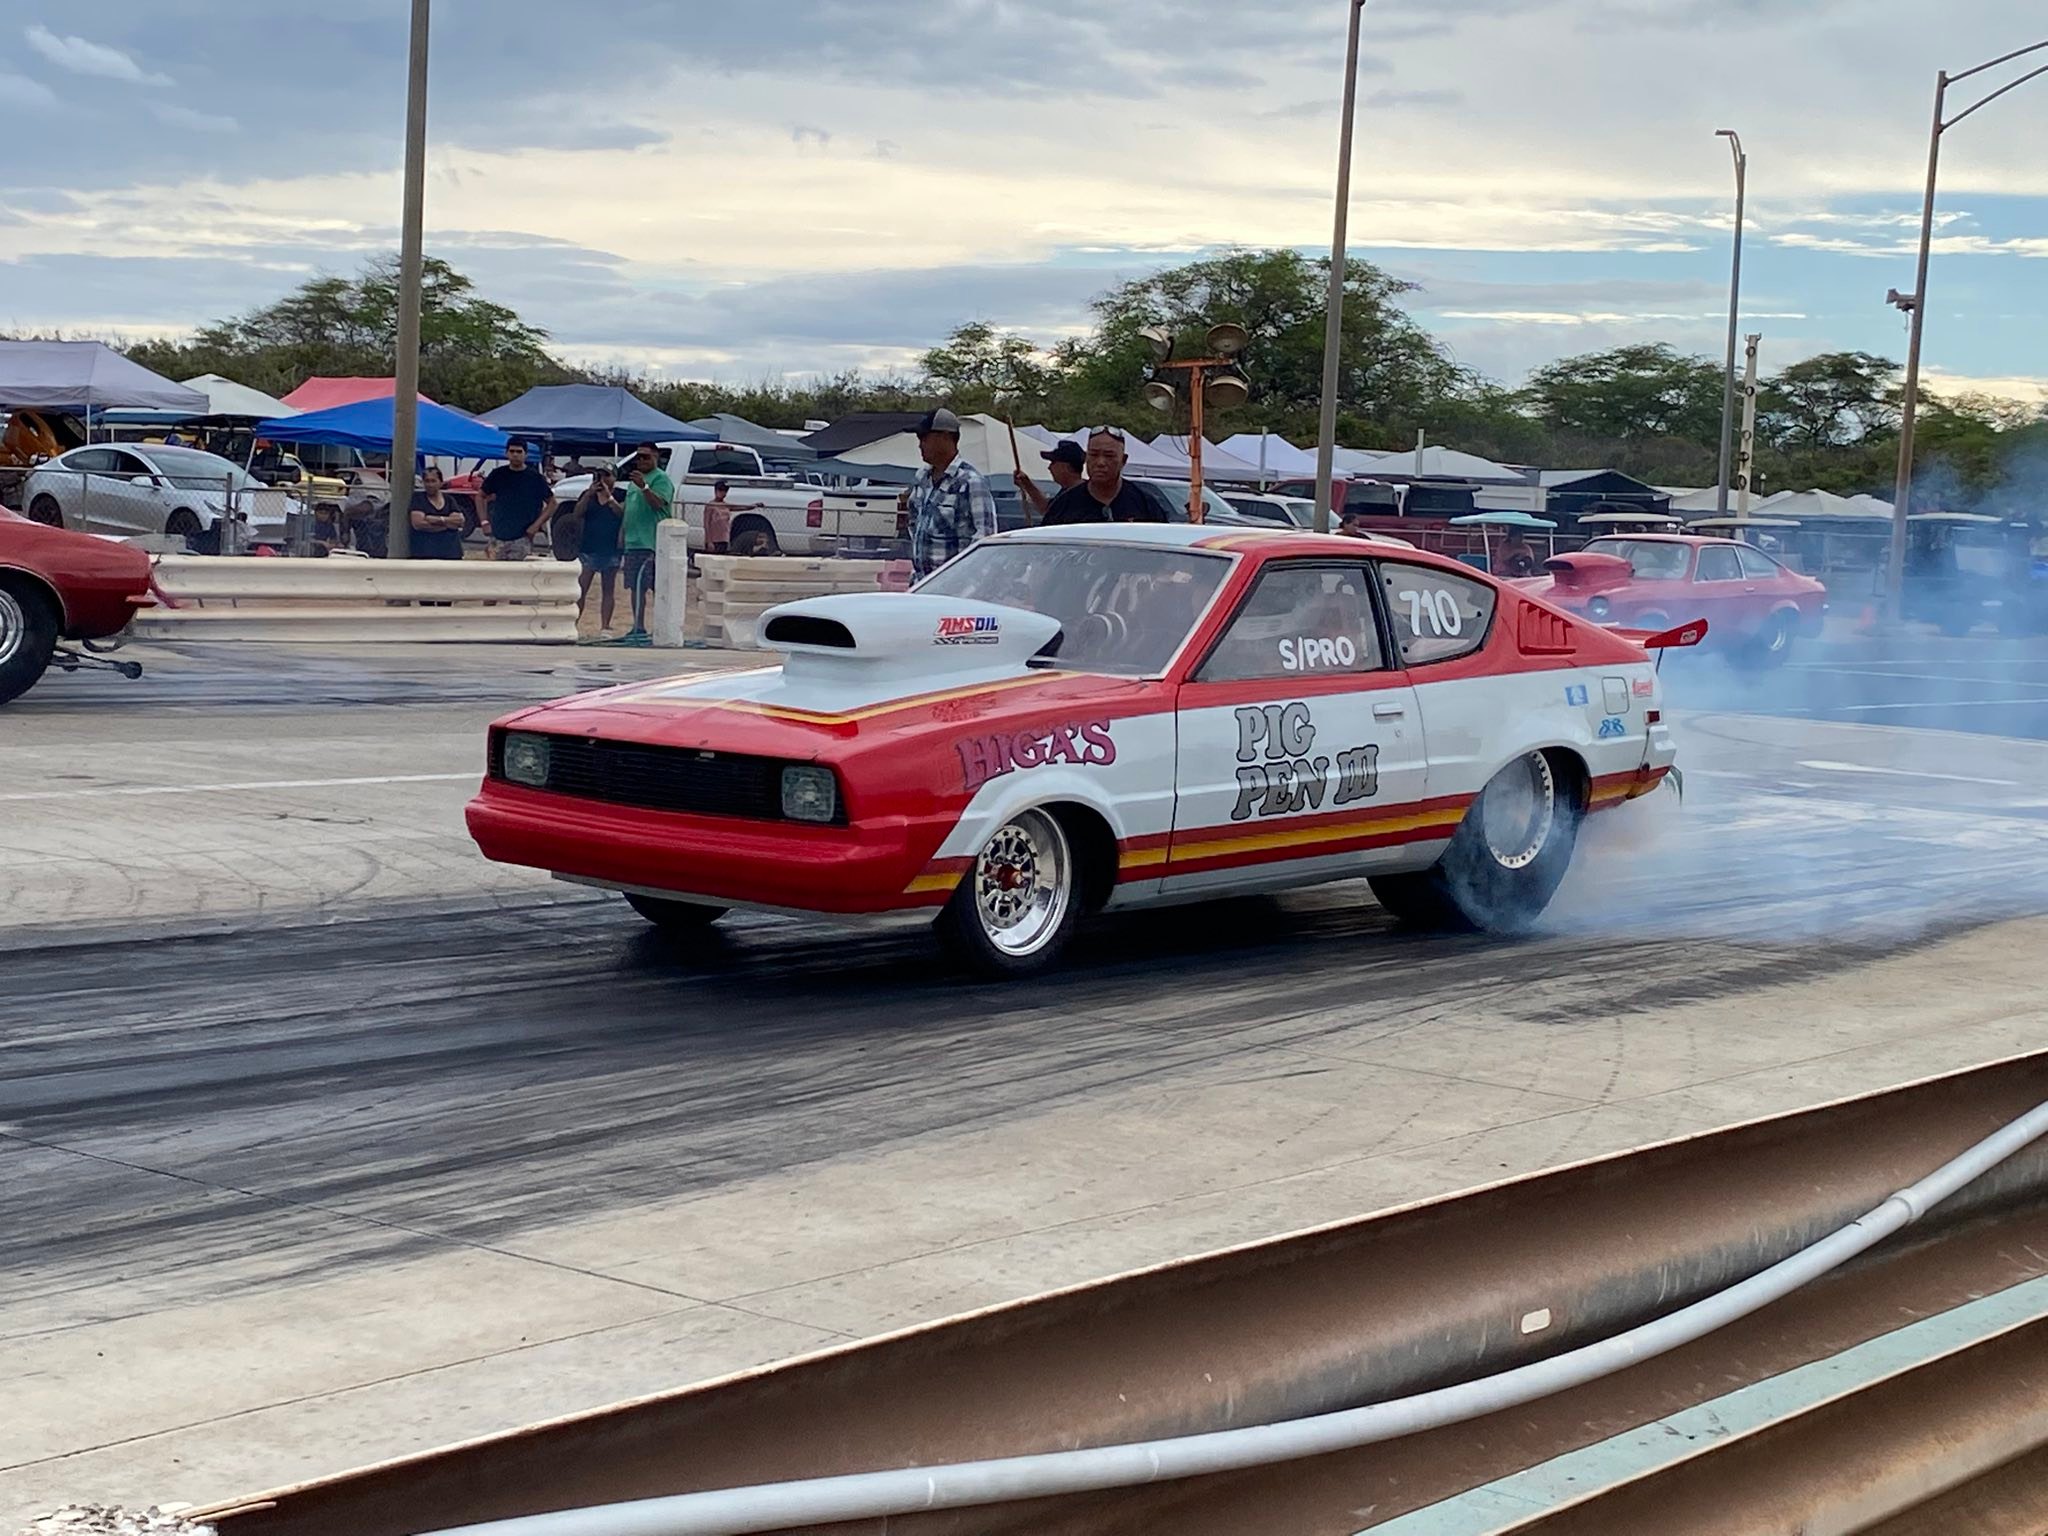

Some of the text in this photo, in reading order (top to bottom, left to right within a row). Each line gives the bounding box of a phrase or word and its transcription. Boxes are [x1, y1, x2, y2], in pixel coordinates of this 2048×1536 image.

[938, 616, 999, 636] AMSOIL
[1398, 589, 1462, 636] 710
[956, 719, 1116, 789] HIGA'S
[1234, 702, 1316, 762] PIG
[1231, 756, 1330, 821] PEN
